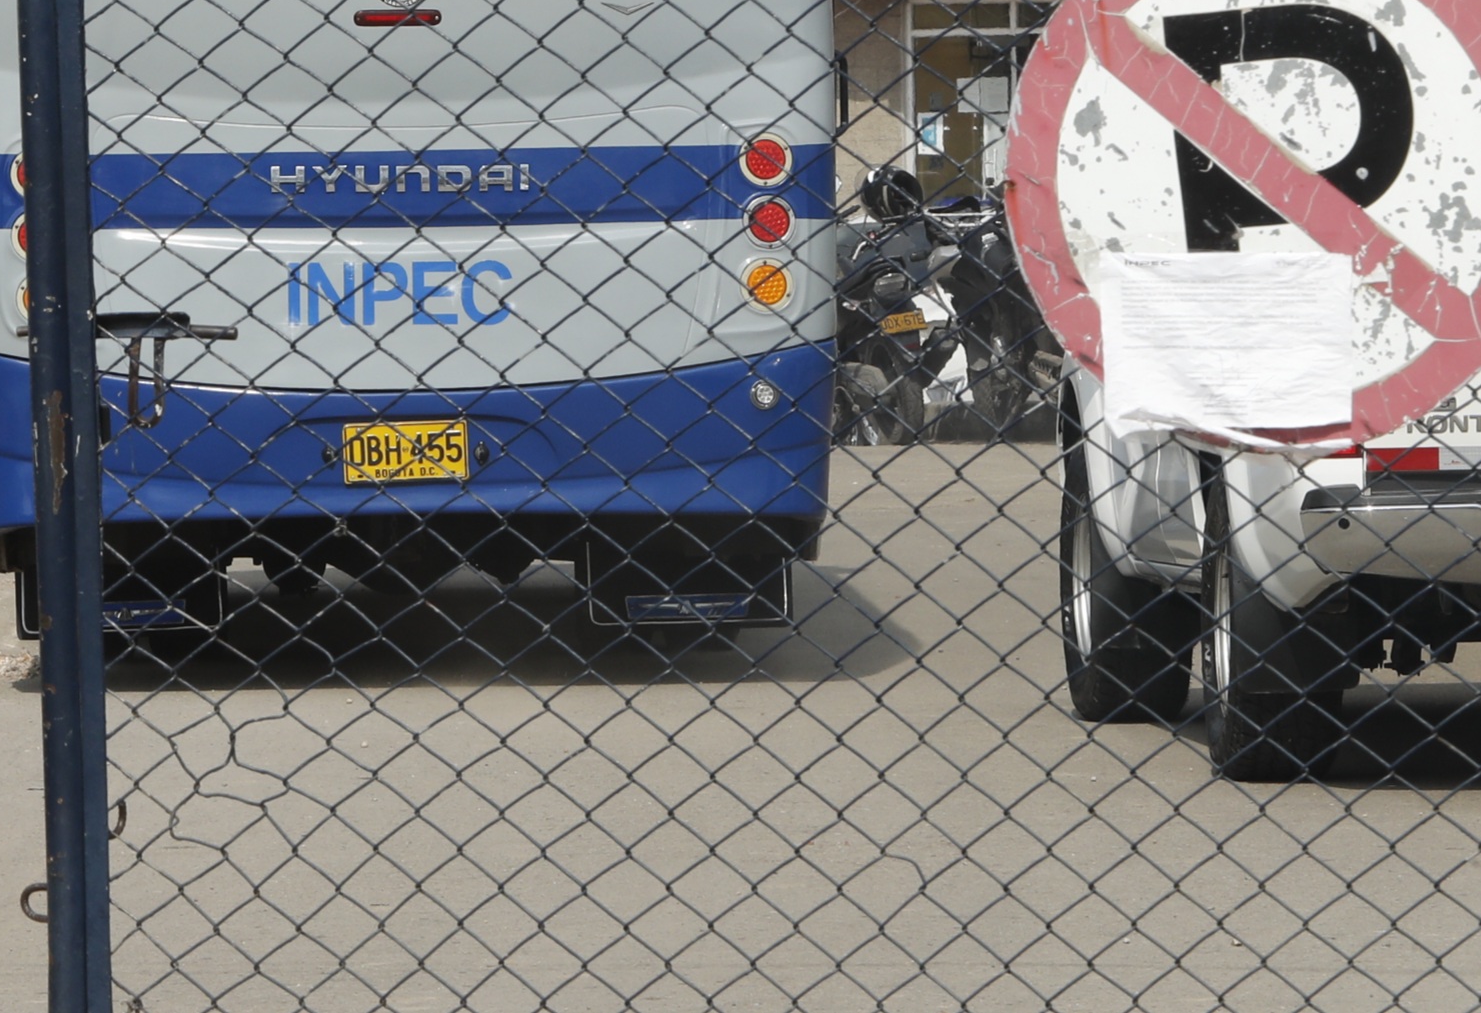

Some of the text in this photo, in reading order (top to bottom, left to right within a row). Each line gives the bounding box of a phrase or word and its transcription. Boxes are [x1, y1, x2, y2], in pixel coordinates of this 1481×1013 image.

[270, 163, 530, 194] HYUNDAI
[286, 259, 514, 326] INPEC
[1389, 415, 1481, 434] RONT
[410, 429, 462, 464] 455
